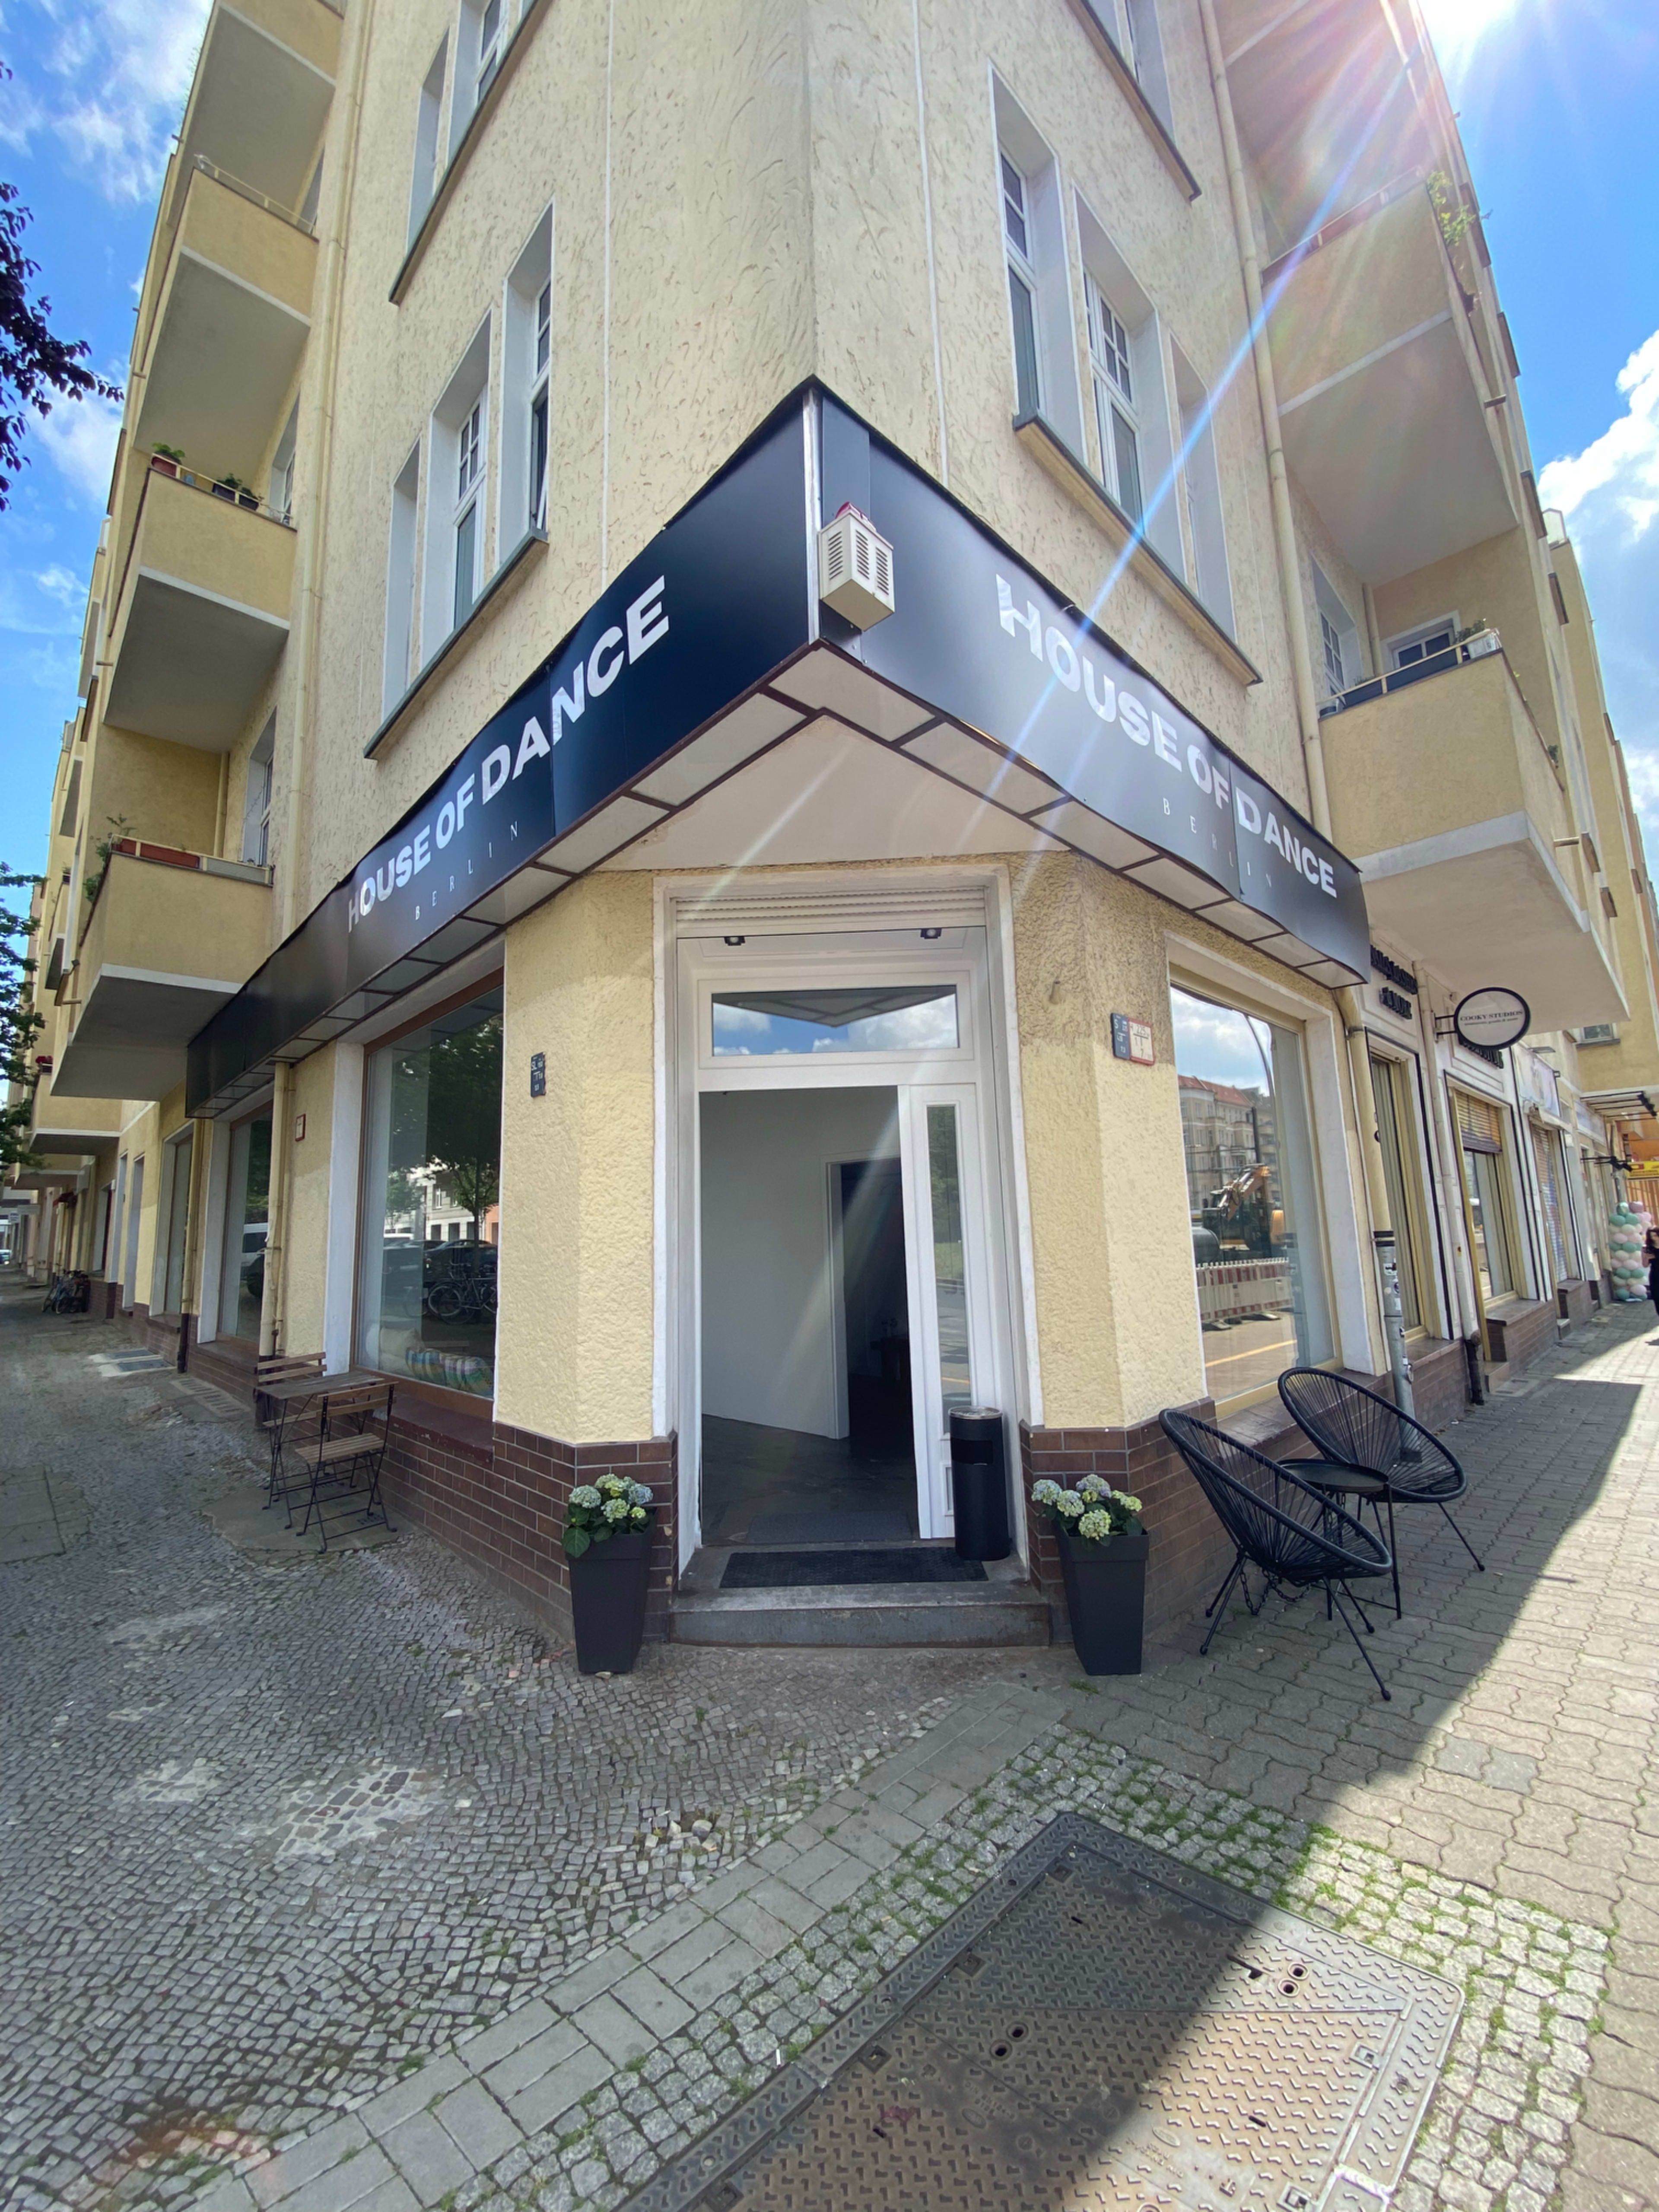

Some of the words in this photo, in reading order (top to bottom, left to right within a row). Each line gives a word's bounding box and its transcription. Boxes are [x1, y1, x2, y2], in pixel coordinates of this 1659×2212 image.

[348, 825, 432, 933] HOUSE
[435, 773, 475, 849] OF
[481, 575, 670, 805] DANCE
[996, 573, 1183, 772] HOUSE
[1187, 744, 1230, 810] OF
[1235, 787, 1338, 899] DANCE
[415, 821, 518, 921] BERLIN
[1163, 798, 1273, 887] BERLIN
[1488, 1010, 1523, 1018] STUDIOS
